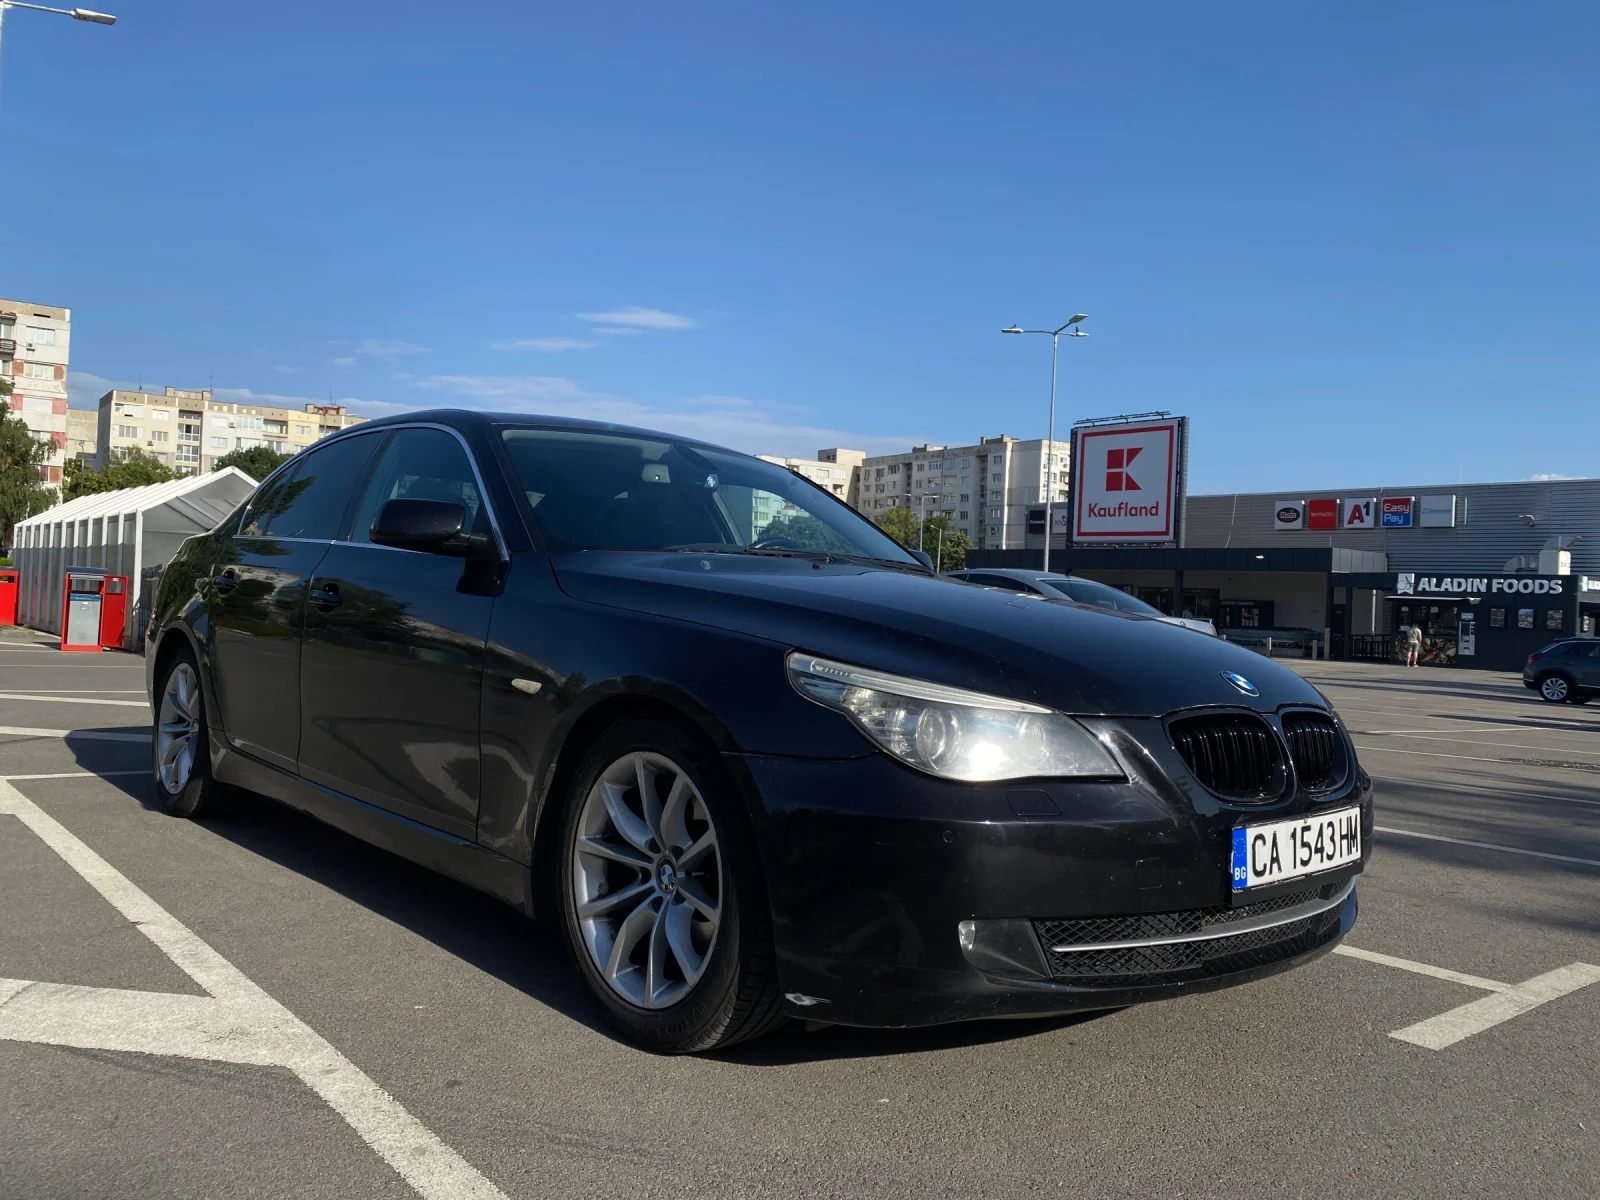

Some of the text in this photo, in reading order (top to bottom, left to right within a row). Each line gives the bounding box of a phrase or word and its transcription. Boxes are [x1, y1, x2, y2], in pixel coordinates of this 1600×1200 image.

[1088, 501, 1159, 517] Kaufland
[1347, 501, 1371, 524] A1
[1384, 503, 1410, 514] Easy
[1384, 514, 1403, 524] Pay
[1417, 577, 1563, 594] ALADIN FOODS
[1252, 814, 1358, 877] CA 1543 HM
[1234, 867, 1247, 880] BG
